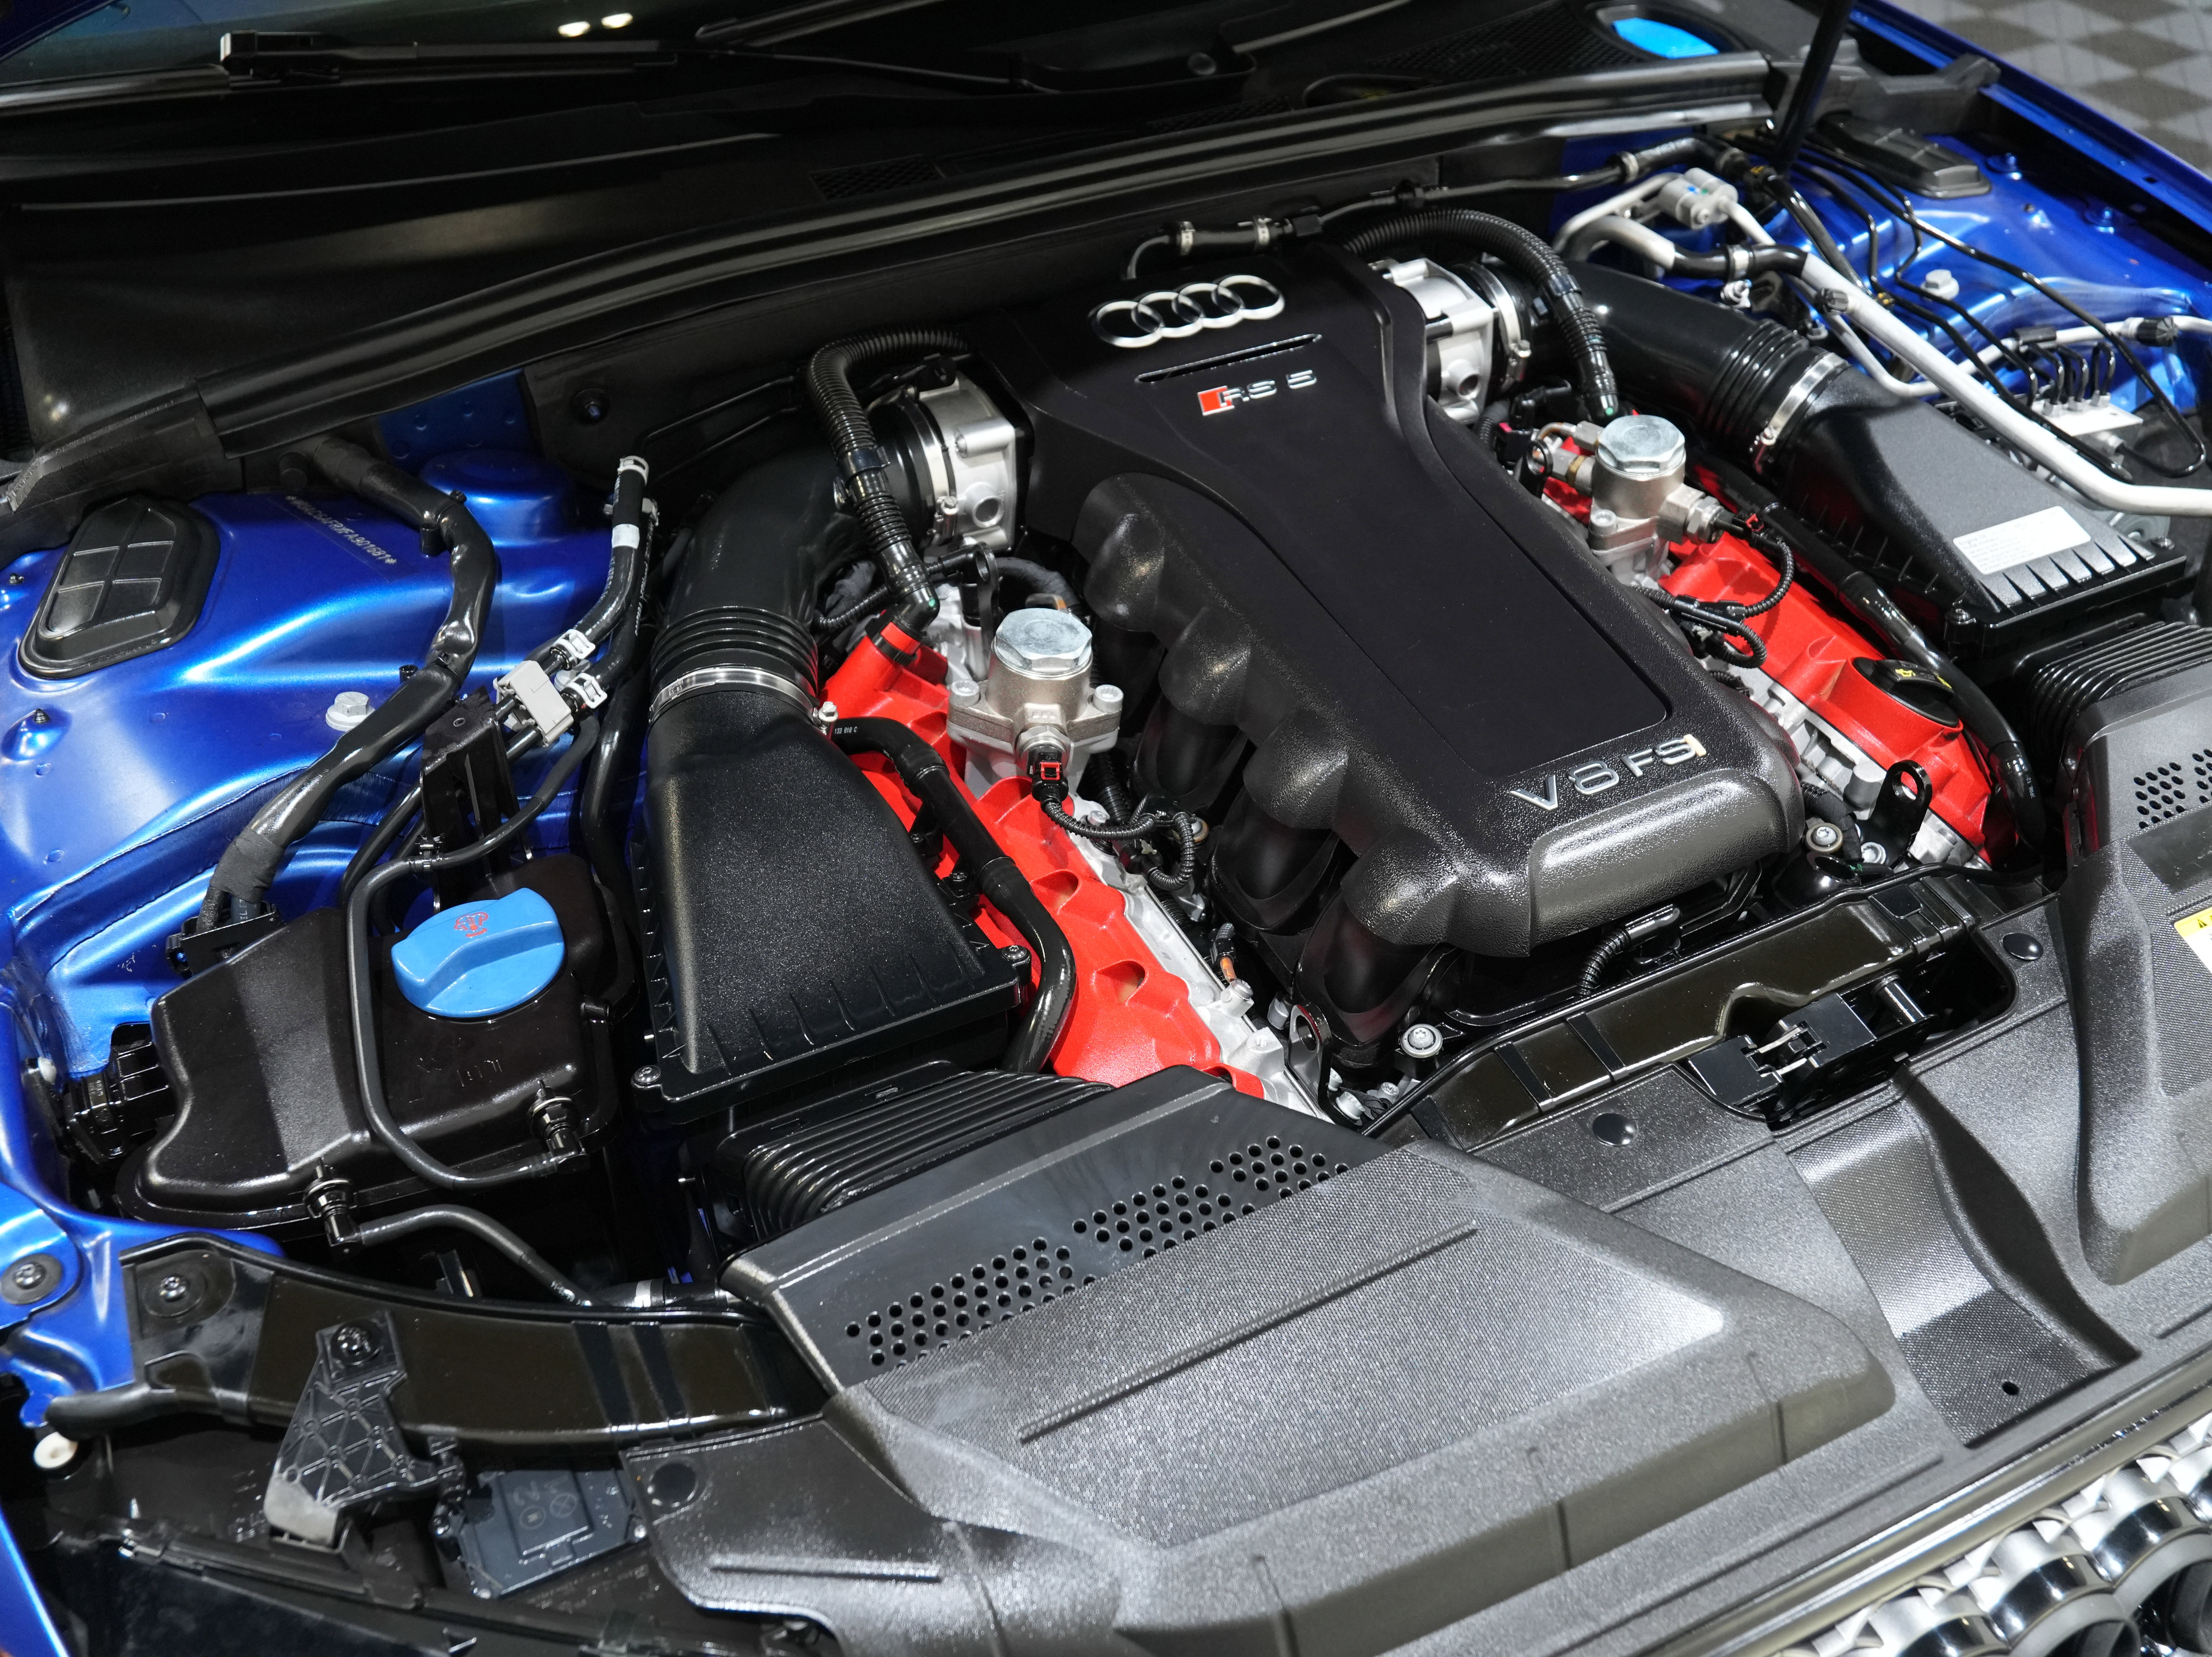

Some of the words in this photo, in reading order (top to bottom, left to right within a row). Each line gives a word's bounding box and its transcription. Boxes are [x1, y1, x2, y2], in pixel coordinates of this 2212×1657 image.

[1220, 379, 1277, 408] RS
[1286, 369, 1318, 390] 5
[1509, 760, 1620, 811] V8
[1622, 734, 1707, 777] FSI
